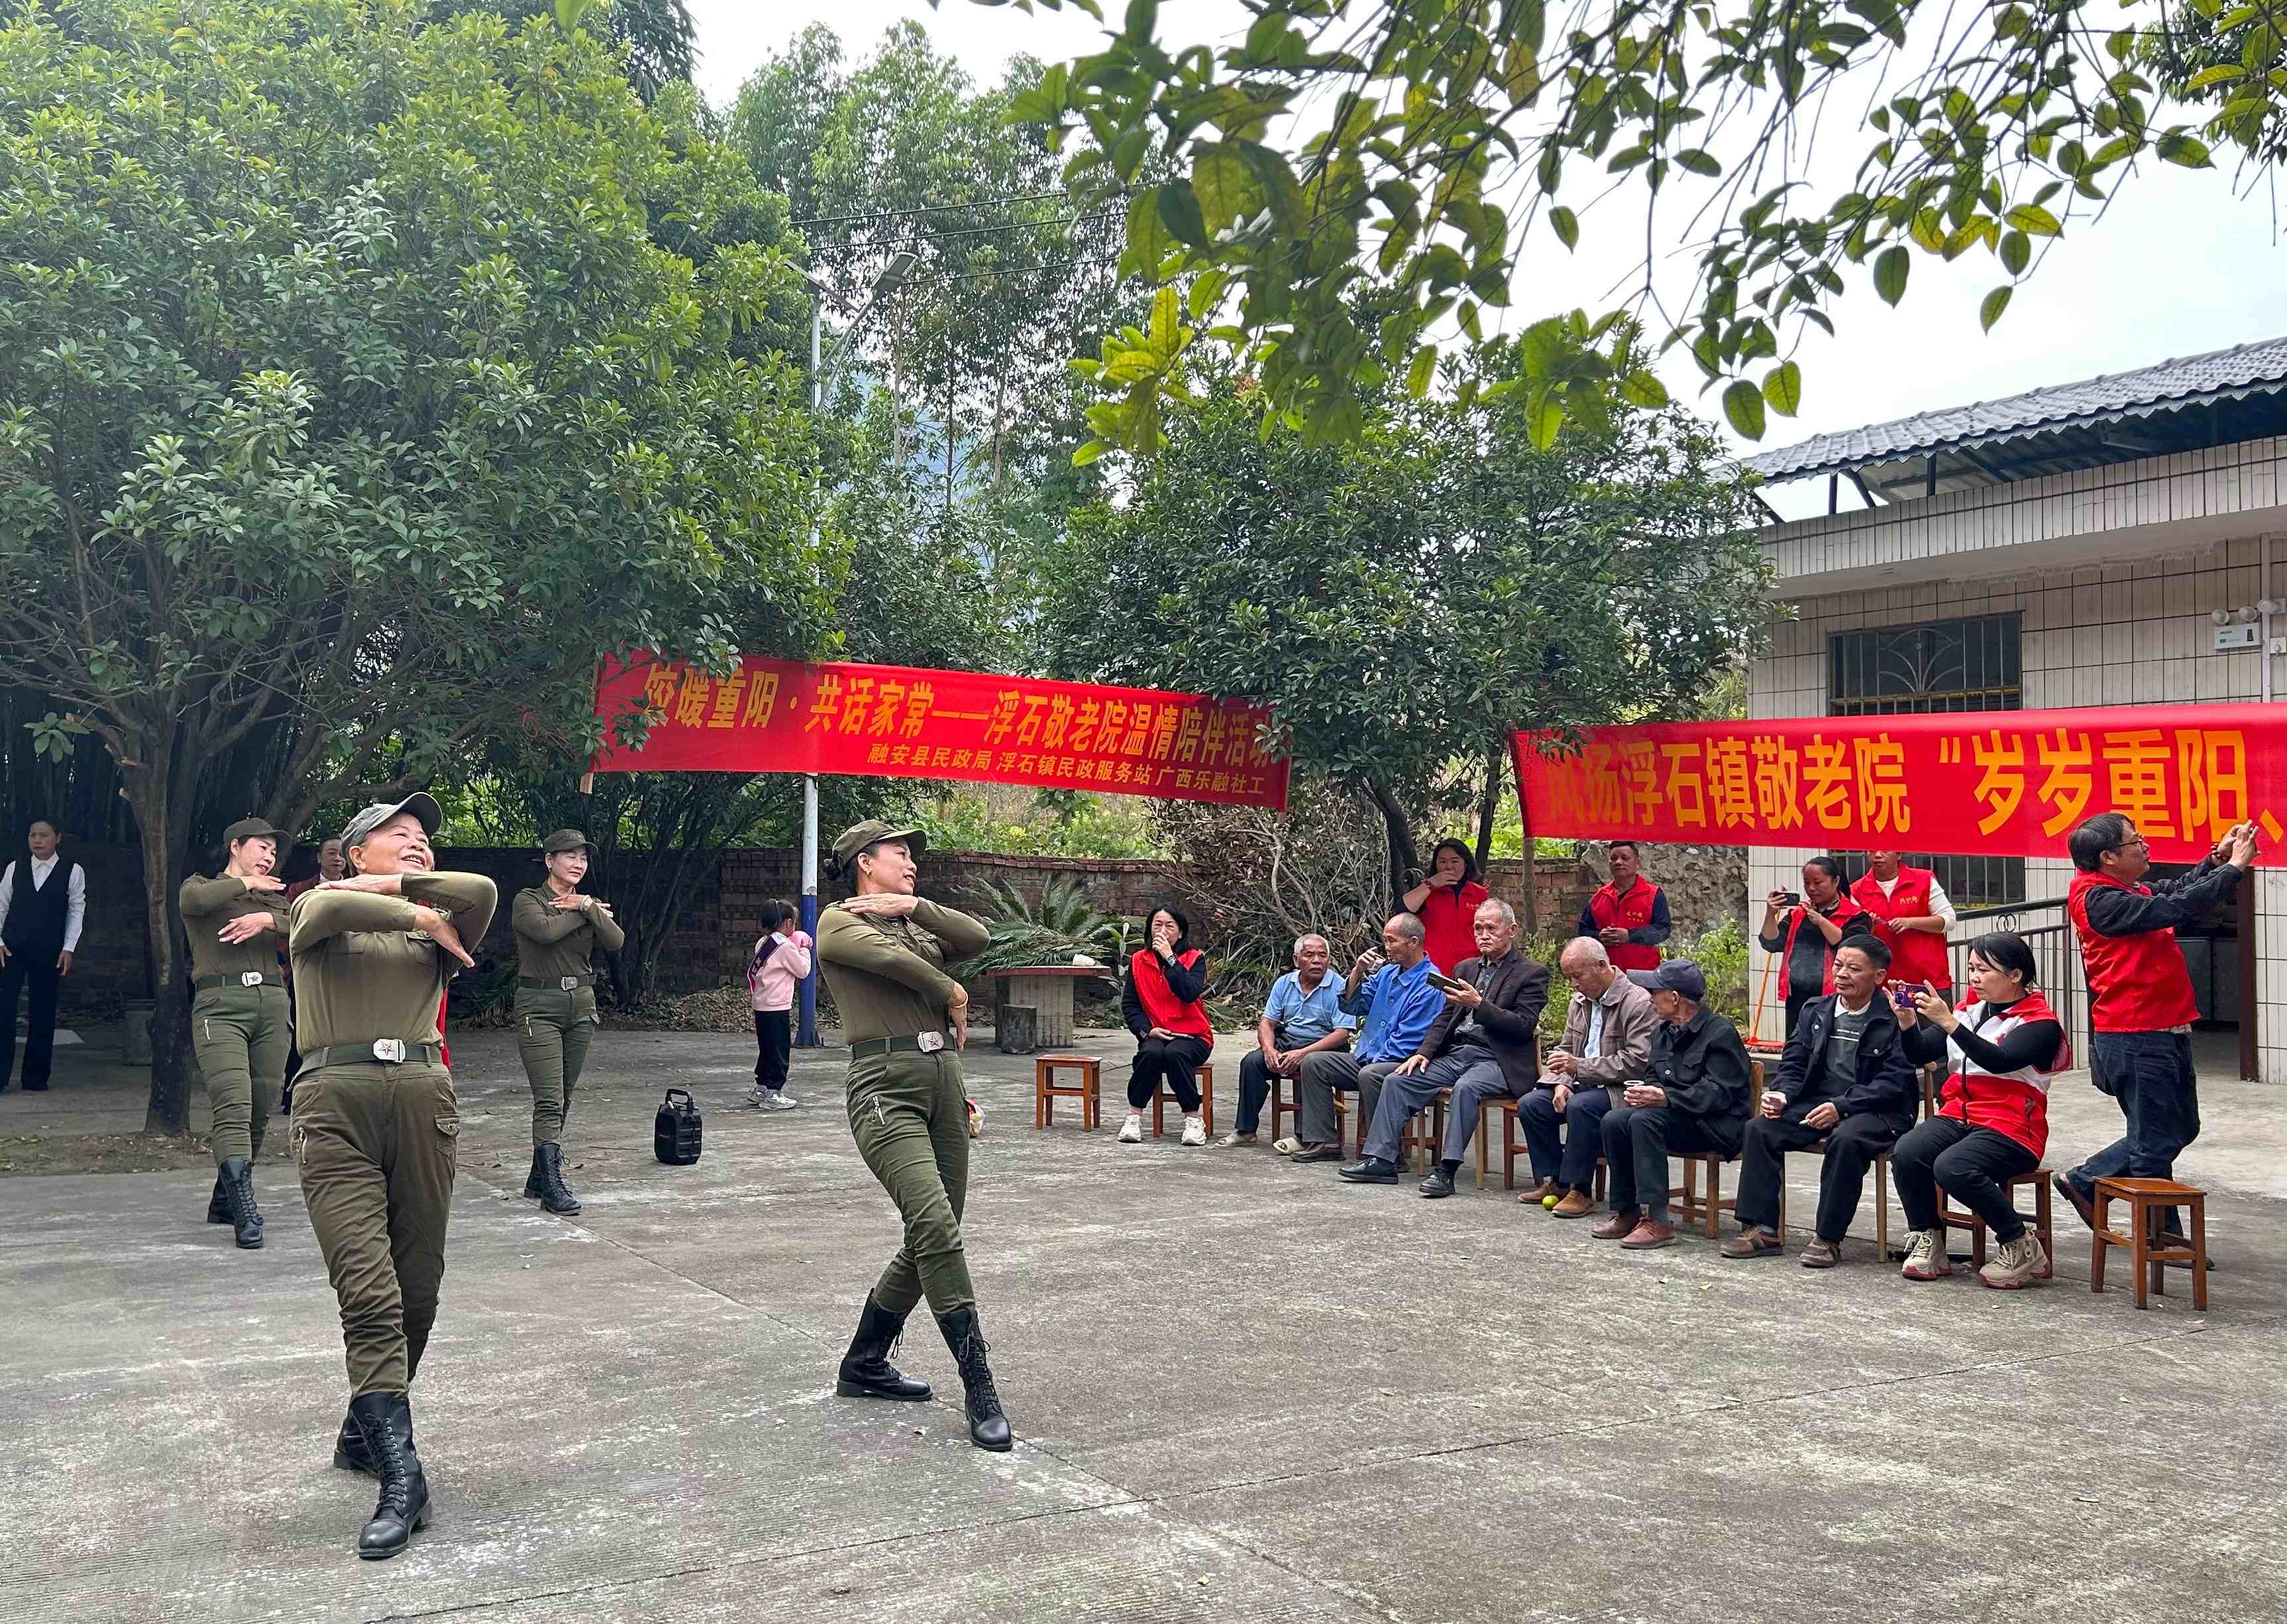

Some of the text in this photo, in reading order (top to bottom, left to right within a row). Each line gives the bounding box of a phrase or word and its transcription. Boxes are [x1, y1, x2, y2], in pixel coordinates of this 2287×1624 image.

[867, 742, 1265, 795] 融安县民政局 浮石镇民政服务站 广西乐融社工
